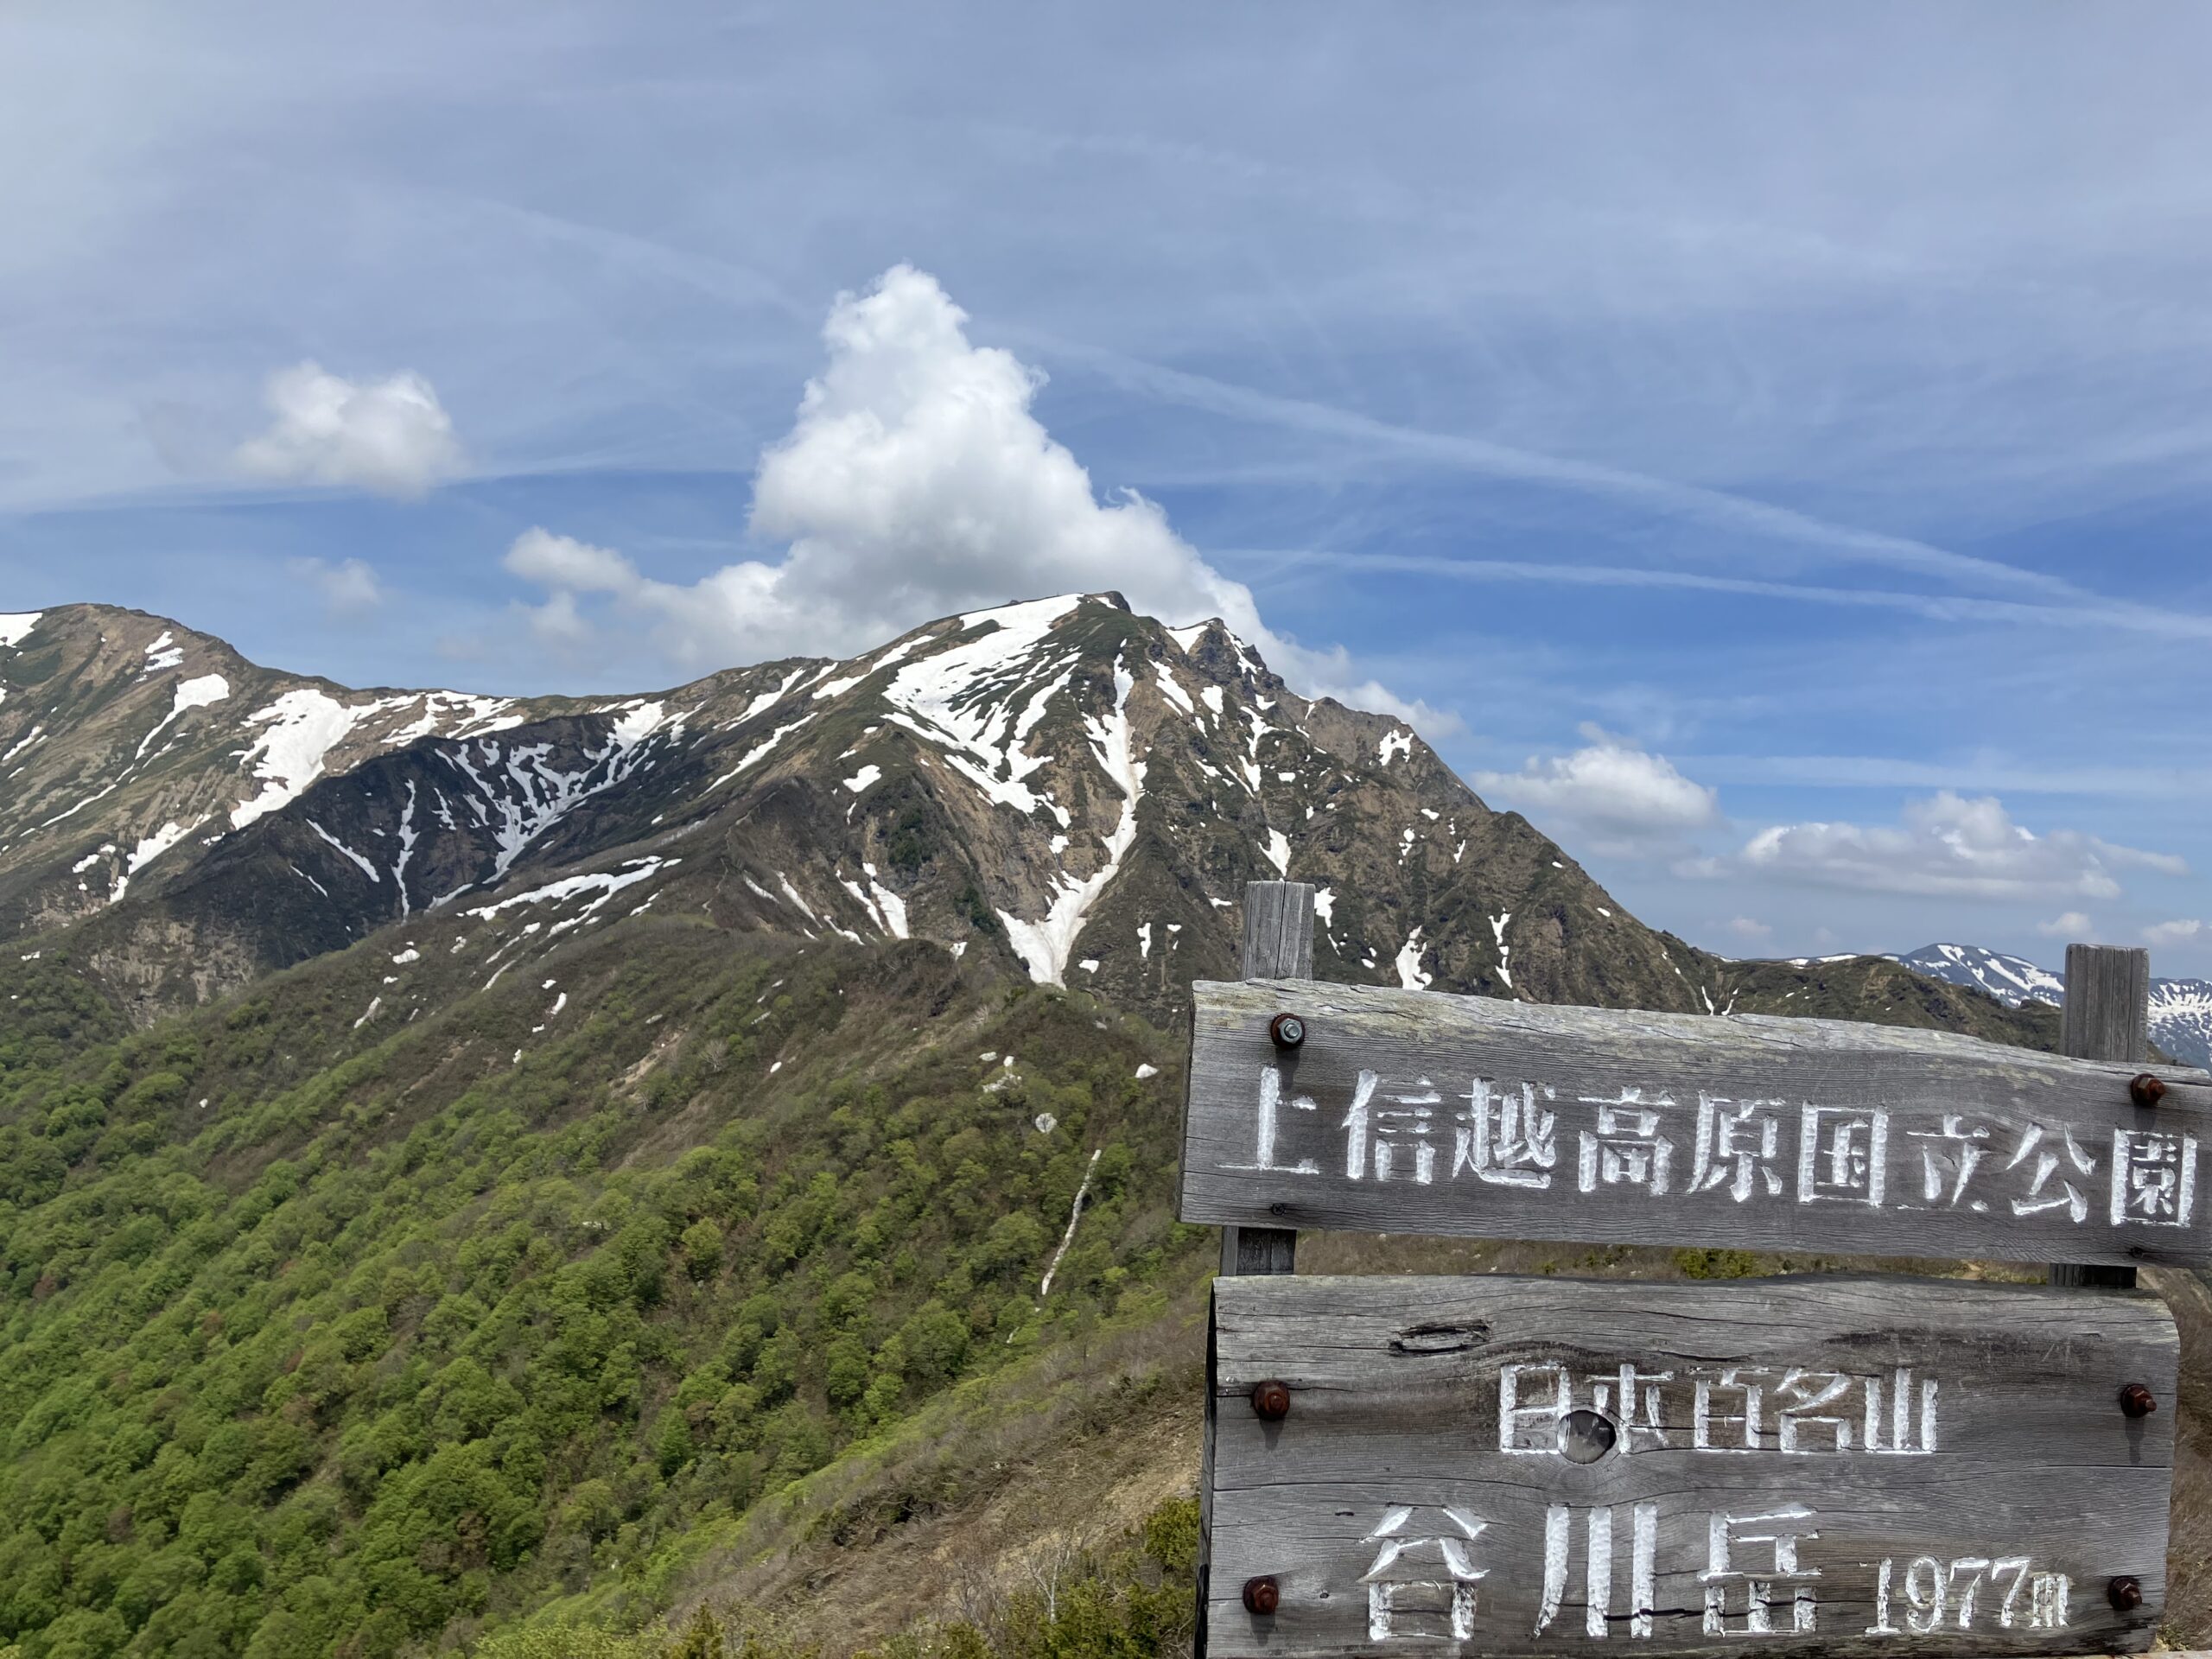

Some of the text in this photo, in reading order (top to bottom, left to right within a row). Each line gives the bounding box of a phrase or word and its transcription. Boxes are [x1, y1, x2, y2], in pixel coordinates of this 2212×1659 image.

[1500, 1363, 1938, 1454] 日本百名山
[1357, 1502, 2069, 1640] 谷川岳 1977m
